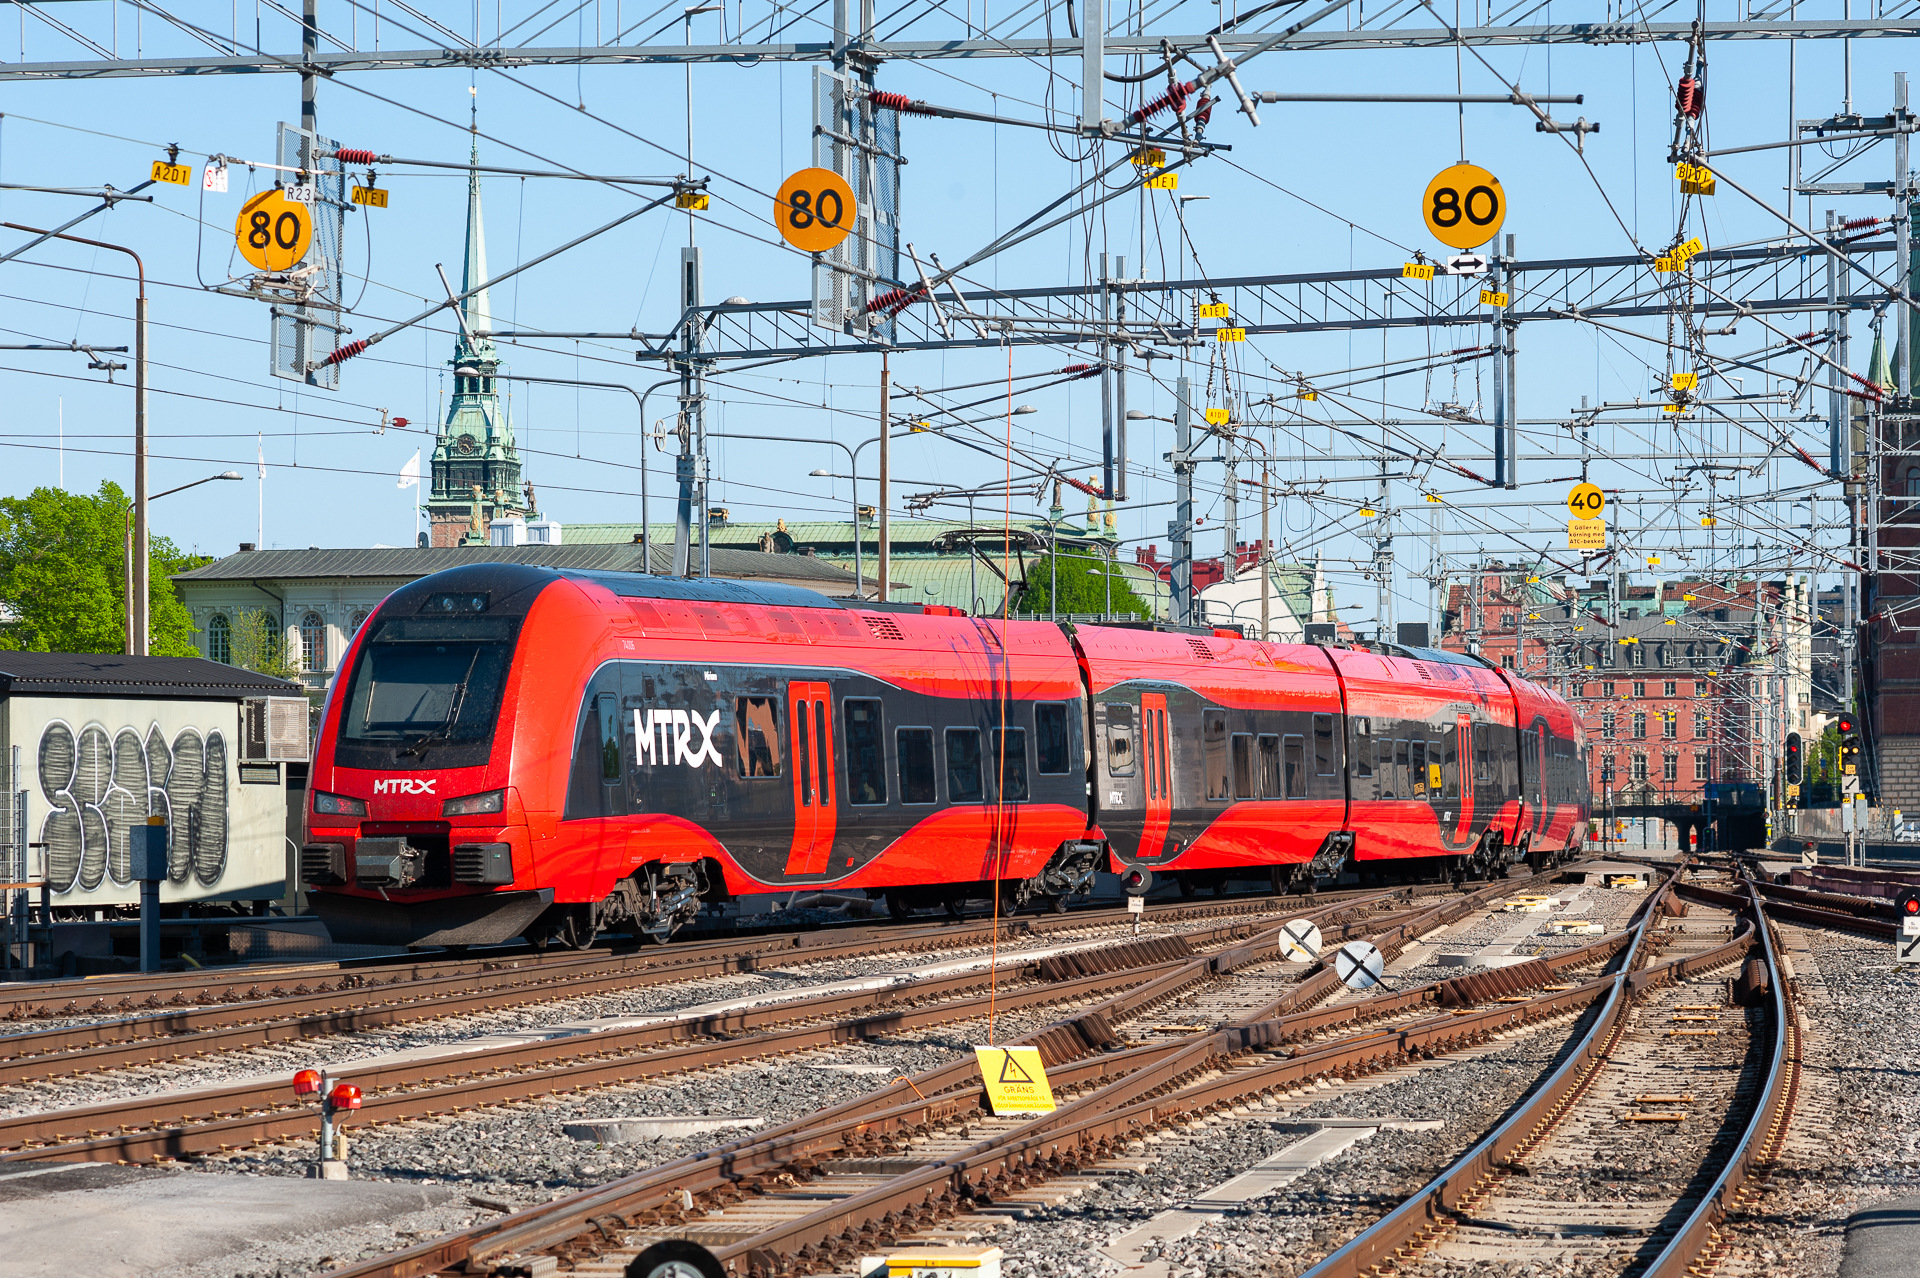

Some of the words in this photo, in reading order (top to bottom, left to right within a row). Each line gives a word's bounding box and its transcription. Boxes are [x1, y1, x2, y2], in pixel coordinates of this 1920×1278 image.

[153, 168, 187, 184] A2D1
[287, 187, 311, 201] R23
[354, 192, 384, 206] A1E1
[789, 188, 843, 229] 80
[1432, 185, 1498, 227] 80
[248, 210, 301, 249] 80
[1676, 241, 1700, 262] B1E1
[1405, 266, 1431, 279] A1D1
[1481, 293, 1505, 306] B1E1
[1202, 306, 1226, 317] A1E1
[1219, 331, 1243, 341] A1E1
[1571, 492, 1602, 510] 40
[633, 708, 723, 769] MTRX
[373, 778, 437, 795] MTRX
[1003, 1085, 1035, 1094] GRÄNS
